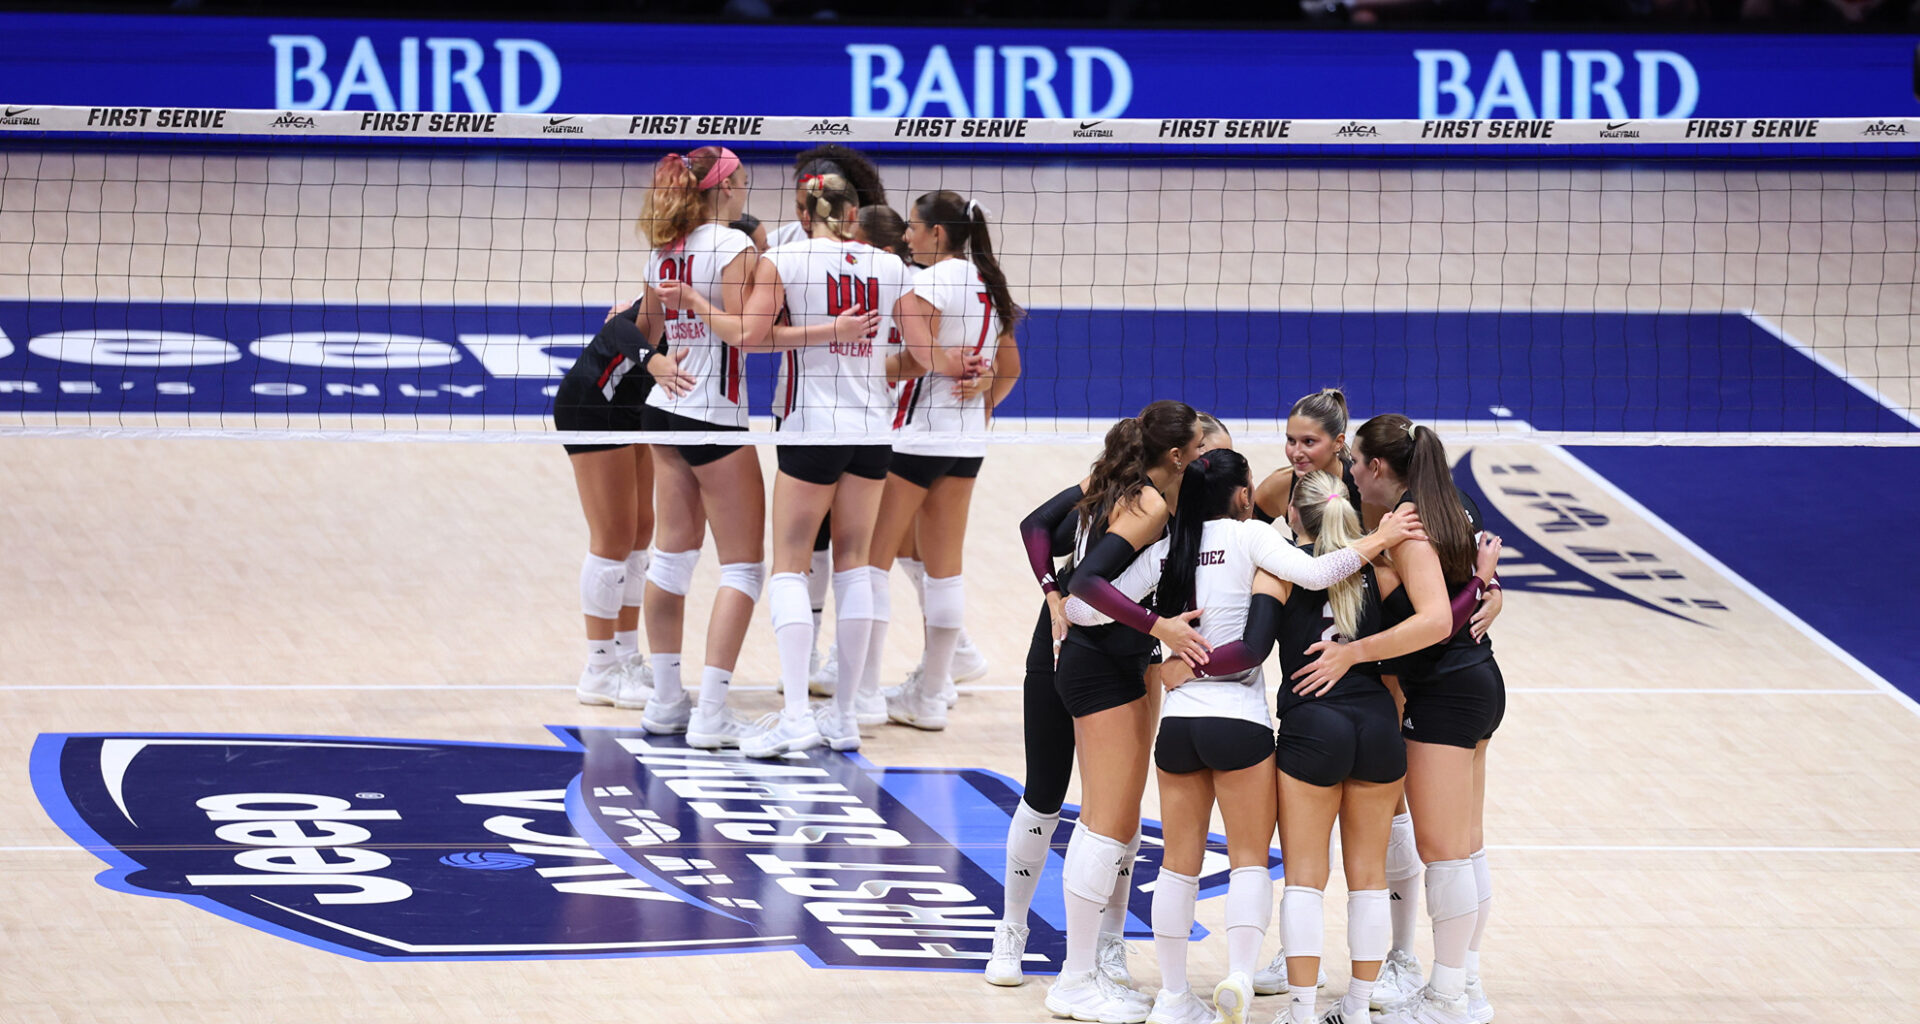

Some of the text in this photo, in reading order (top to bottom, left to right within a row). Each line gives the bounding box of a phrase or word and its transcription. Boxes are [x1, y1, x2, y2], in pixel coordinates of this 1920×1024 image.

[269, 35, 561, 114] BAIRD
[846, 44, 1133, 119] BAIRD
[1413, 49, 1699, 120] BAIRD
[88, 109, 225, 129] FIRST SERVE
[273, 115, 315, 128] AVCA
[360, 112, 497, 132] FIRST SERVE
[629, 117, 764, 136] FIRST SERVE
[895, 118, 1028, 138] FIRST SERVE
[543, 125, 584, 134] VOLLEYBALL
[808, 122, 850, 136] AVCA
[1073, 129, 1113, 138] VOLLEYBALL
[1159, 120, 1290, 138] FIRST SERVE
[1338, 124, 1378, 137] AVCA
[1422, 120, 1555, 139] FIRST SERVE
[1599, 130, 1640, 139] VOLLEYBALL
[1686, 120, 1818, 138] FIRST SERVE
[1864, 122, 1906, 136] AVCA
[250, 382, 487, 398] ONLY
[186, 792, 414, 905] Jeep
[456, 785, 762, 908] AVCA
[746, 854, 1050, 961] FIRST
